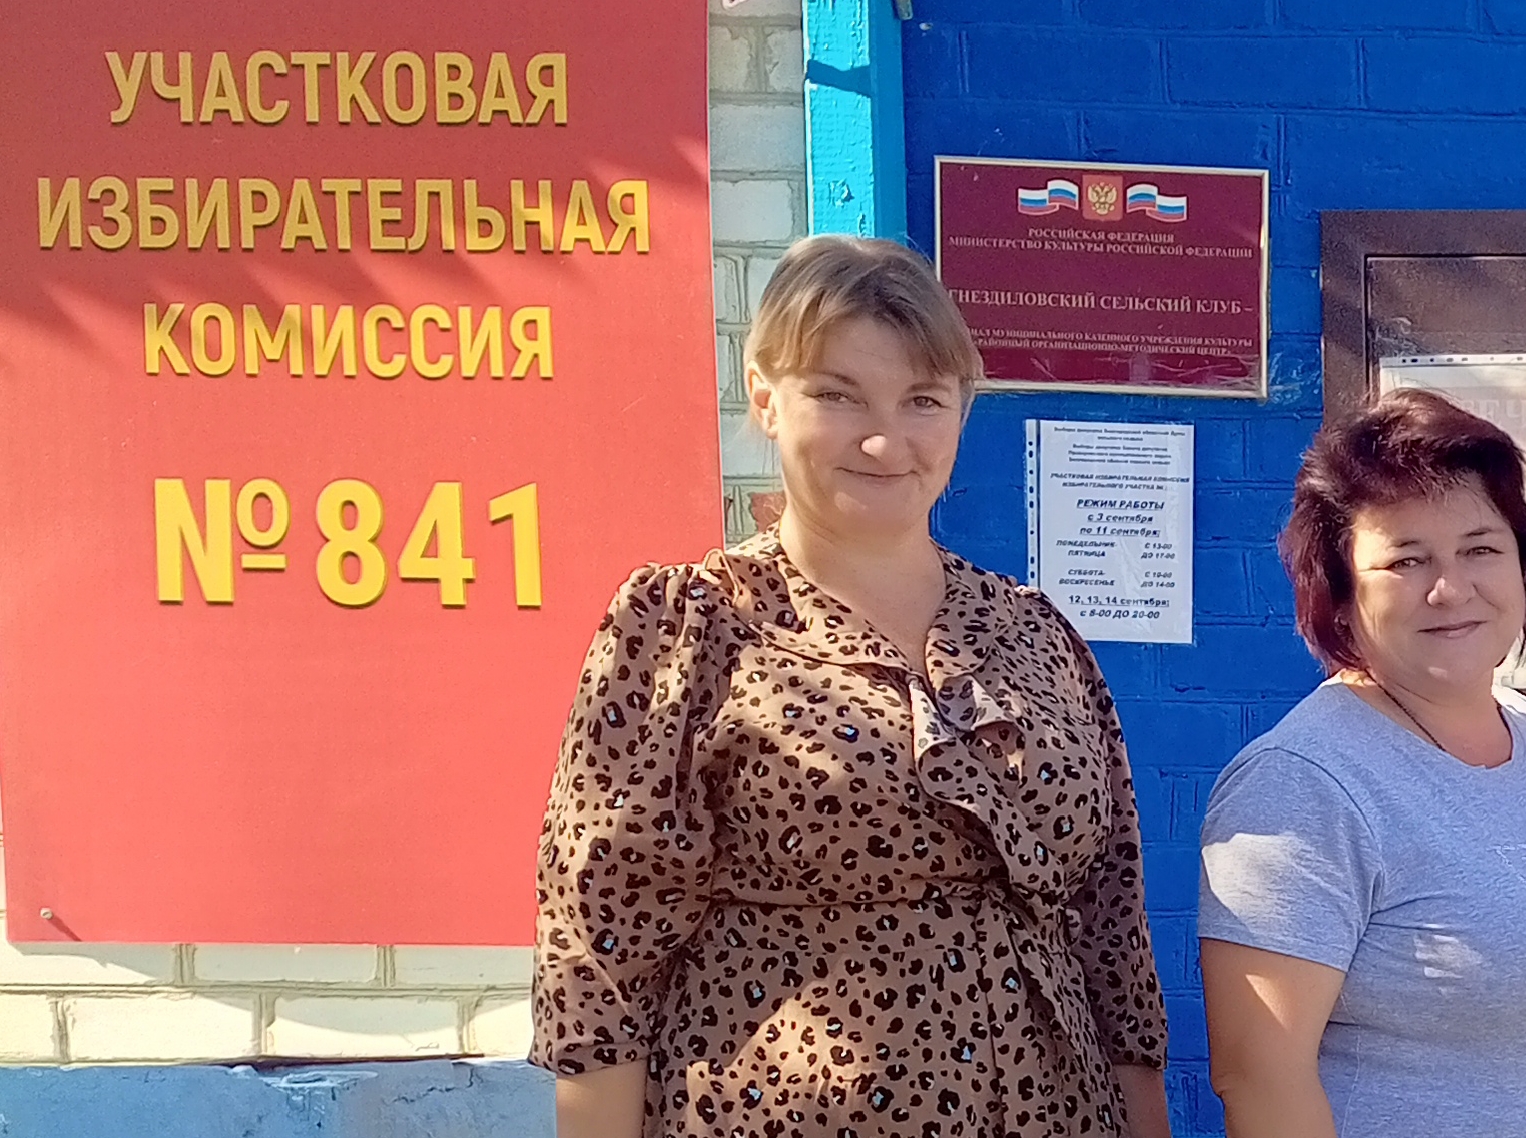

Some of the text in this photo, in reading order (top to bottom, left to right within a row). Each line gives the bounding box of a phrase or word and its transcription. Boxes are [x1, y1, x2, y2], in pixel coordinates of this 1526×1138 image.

[105, 50, 568, 126] УЧАСТКОВАЯ
[37, 176, 651, 254] ИЗБИРАТЕЛЬНАЯ
[1028, 228, 1175, 243] РОССИЙСКАЯ ФЕДЕРАЦИЯ
[949, 236, 1253, 258] МИНИСТЕРСТВО КУЛЬТУРЫ РОССИЙСКОЙ ФЕДЕРАЦИИ
[949, 288, 1096, 309] ГНЕЗДИЛОВСКИЙ
[1099, 295, 1191, 312] СЕЛЬСКИЙ
[1196, 299, 1242, 314] КЛУБ
[143, 303, 554, 379] КОМИССИЯ
[1076, 499, 1165, 510] РЕЖИМ РАБОТЫ
[1087, 513, 1154, 524] с 3 сентября
[1080, 527, 1093, 535] по
[1096, 526, 1107, 535] 11
[153, 477, 542, 609] № 841
[1068, 550, 1106, 558] ПЯТНИЦА
[1069, 595, 1084, 605] 12,
[1087, 595, 1102, 605] 13,
[1105, 596, 1117, 604] 14
[1089, 609, 1111, 618] 8-00
[1112, 610, 1129, 619] ДО
[1131, 610, 1160, 619] 20-00
